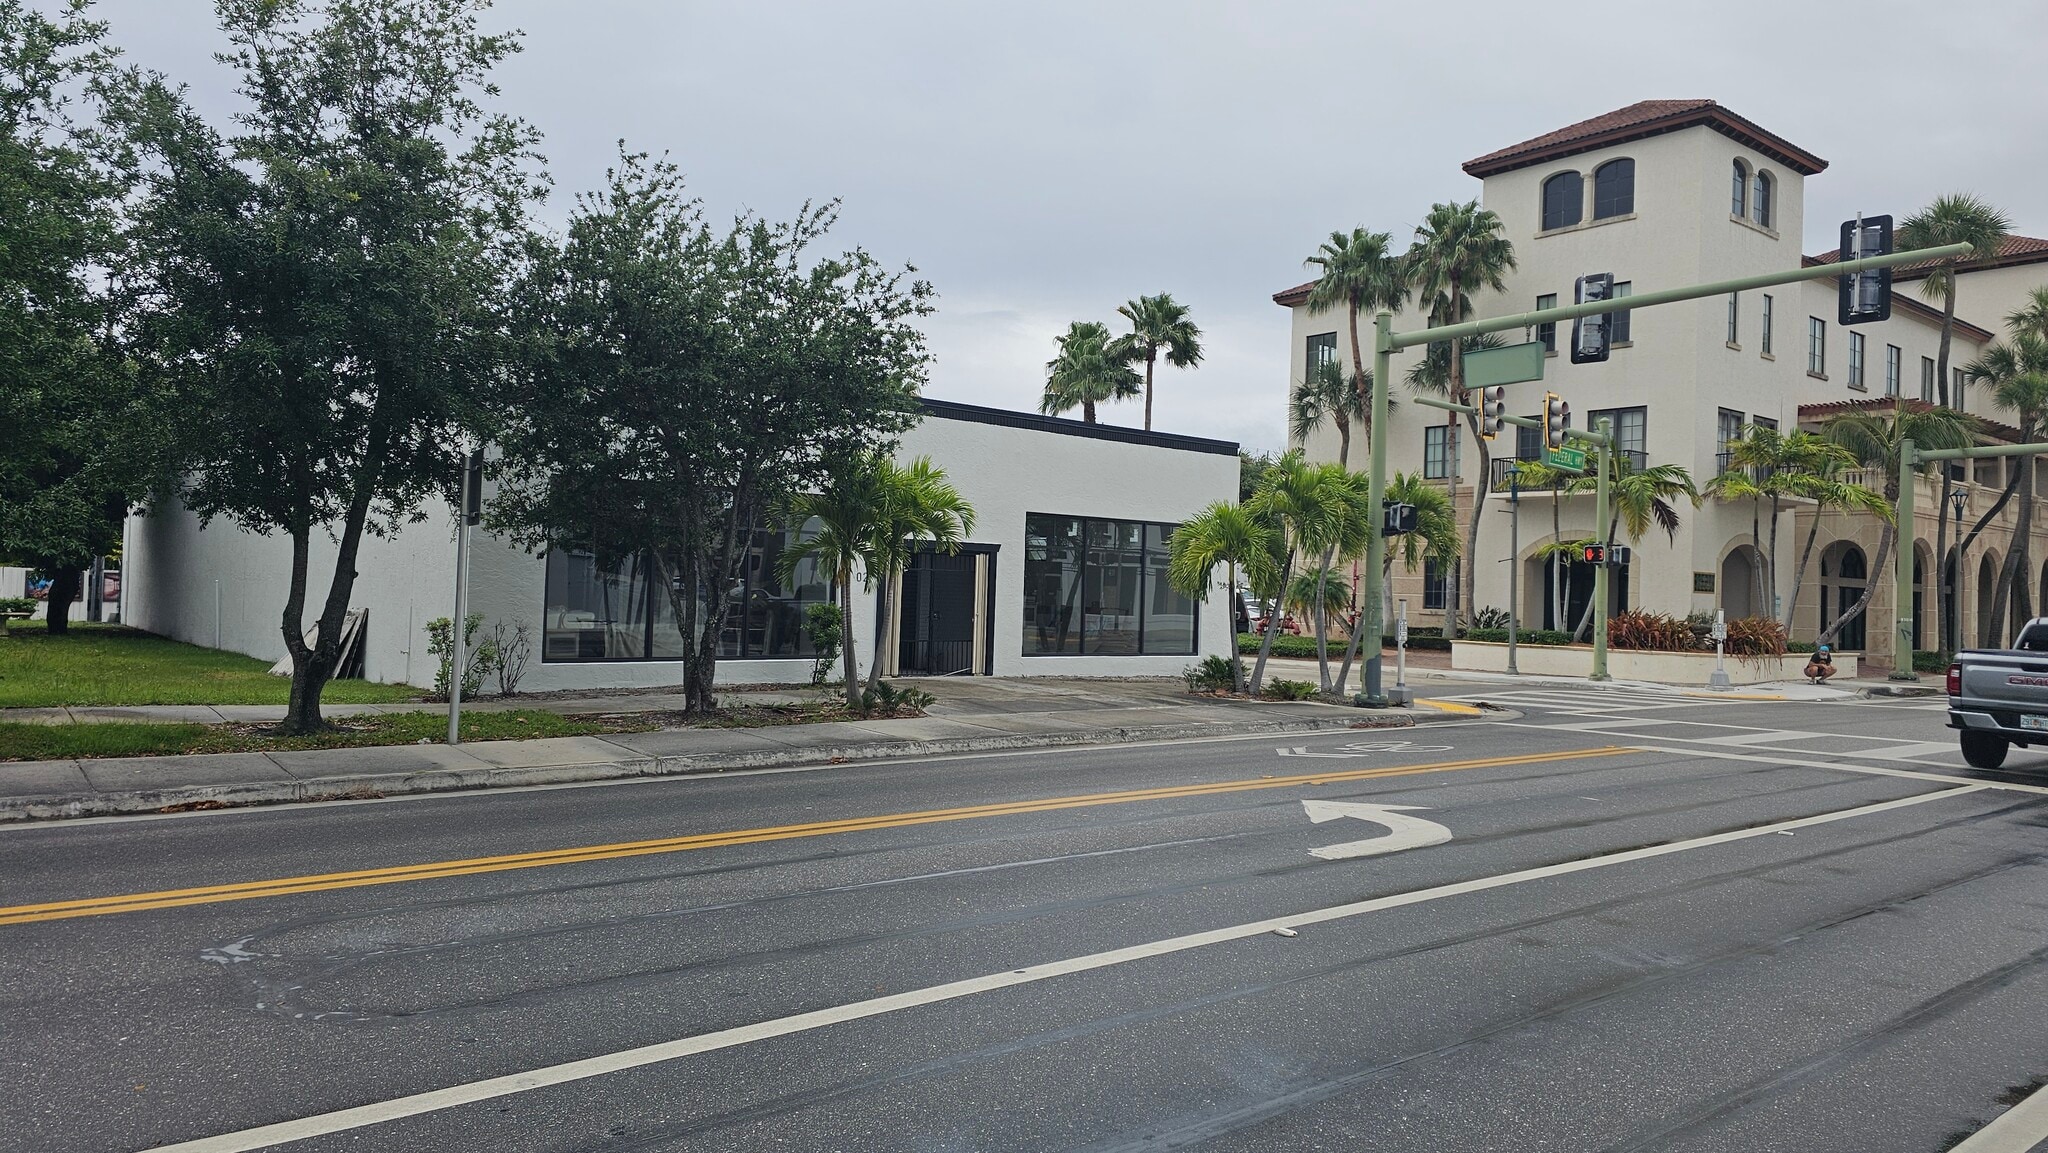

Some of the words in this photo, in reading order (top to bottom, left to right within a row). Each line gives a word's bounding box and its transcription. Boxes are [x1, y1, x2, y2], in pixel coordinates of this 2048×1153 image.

[1551, 450, 1574, 465] FEDERAL
[1599, 549, 1604, 560] 3
[2009, 675, 2048, 686] GM
